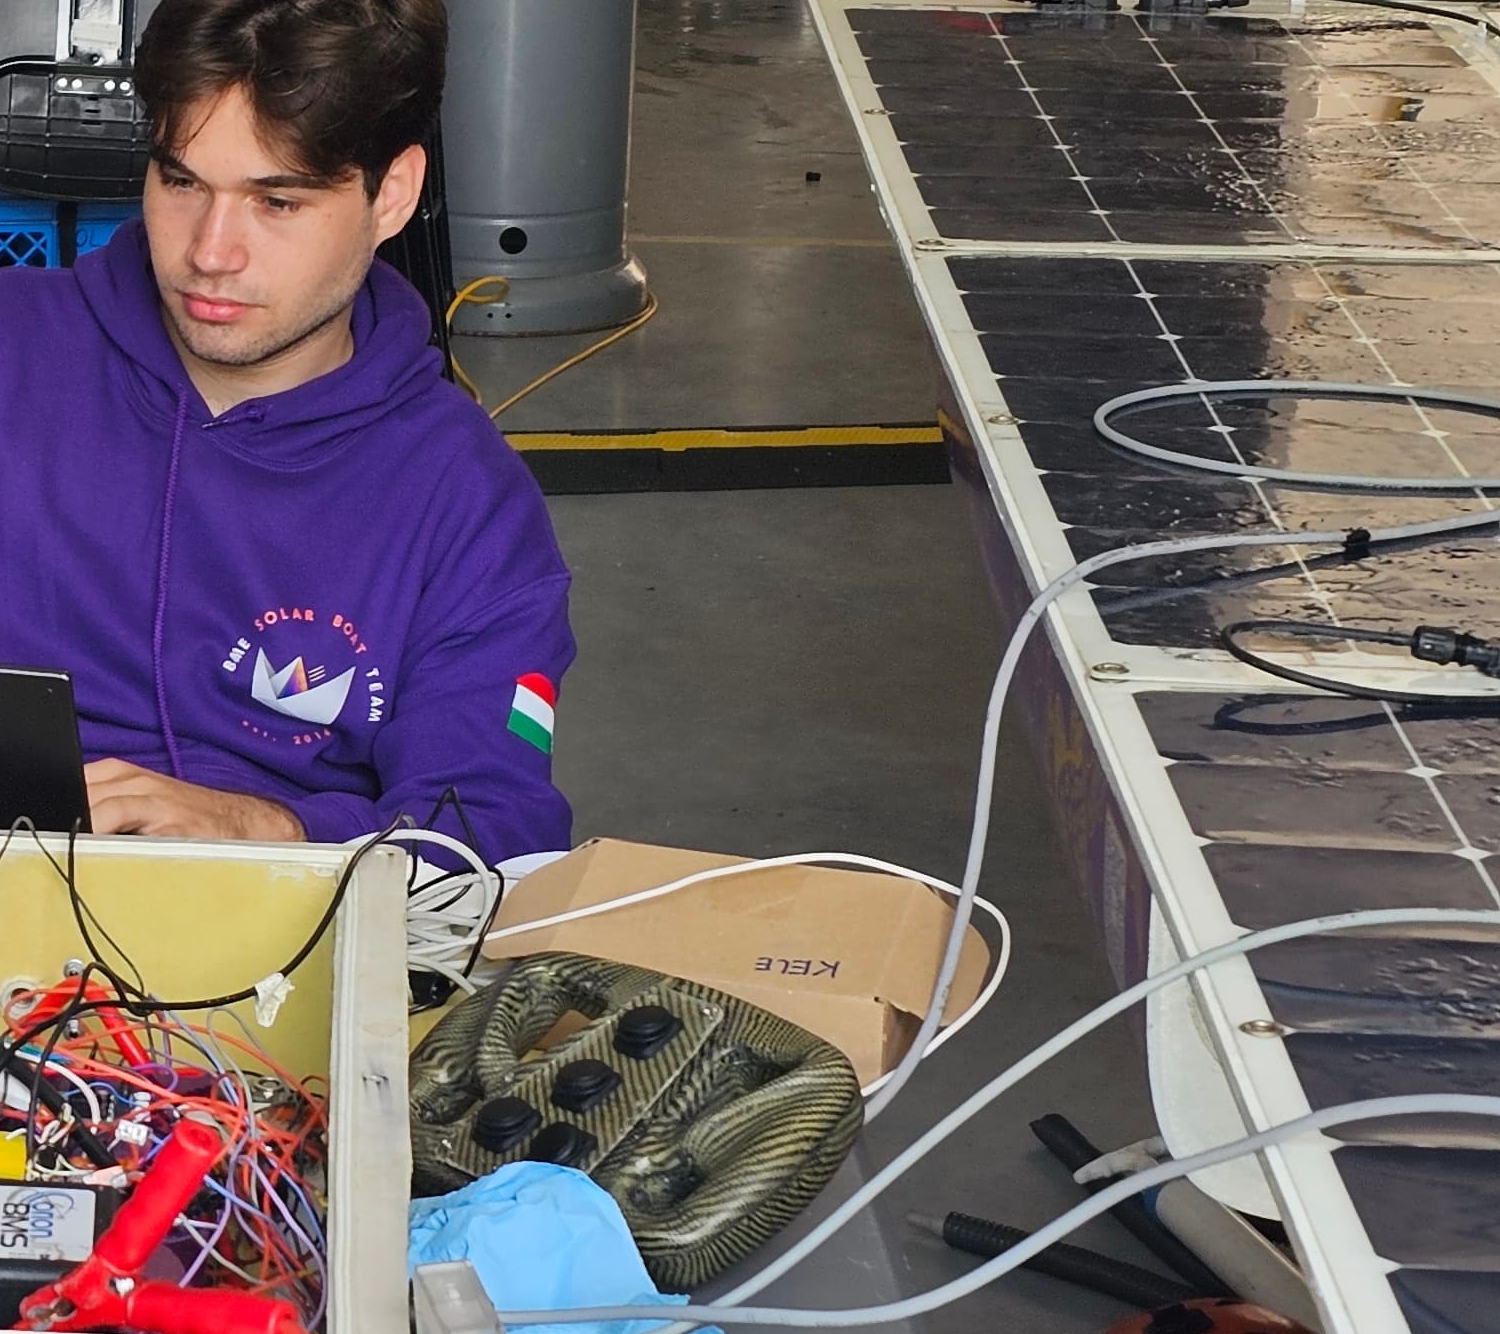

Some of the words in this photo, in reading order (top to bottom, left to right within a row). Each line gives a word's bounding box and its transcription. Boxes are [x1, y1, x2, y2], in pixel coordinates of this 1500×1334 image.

[222, 637, 252, 673] BME
[254, 607, 316, 632] SOLAR
[332, 614, 368, 655] BOAT
[365, 667, 386, 723] TEAM
[754, 956, 841, 979] KELE
[0, 1202, 30, 1249] BMS
